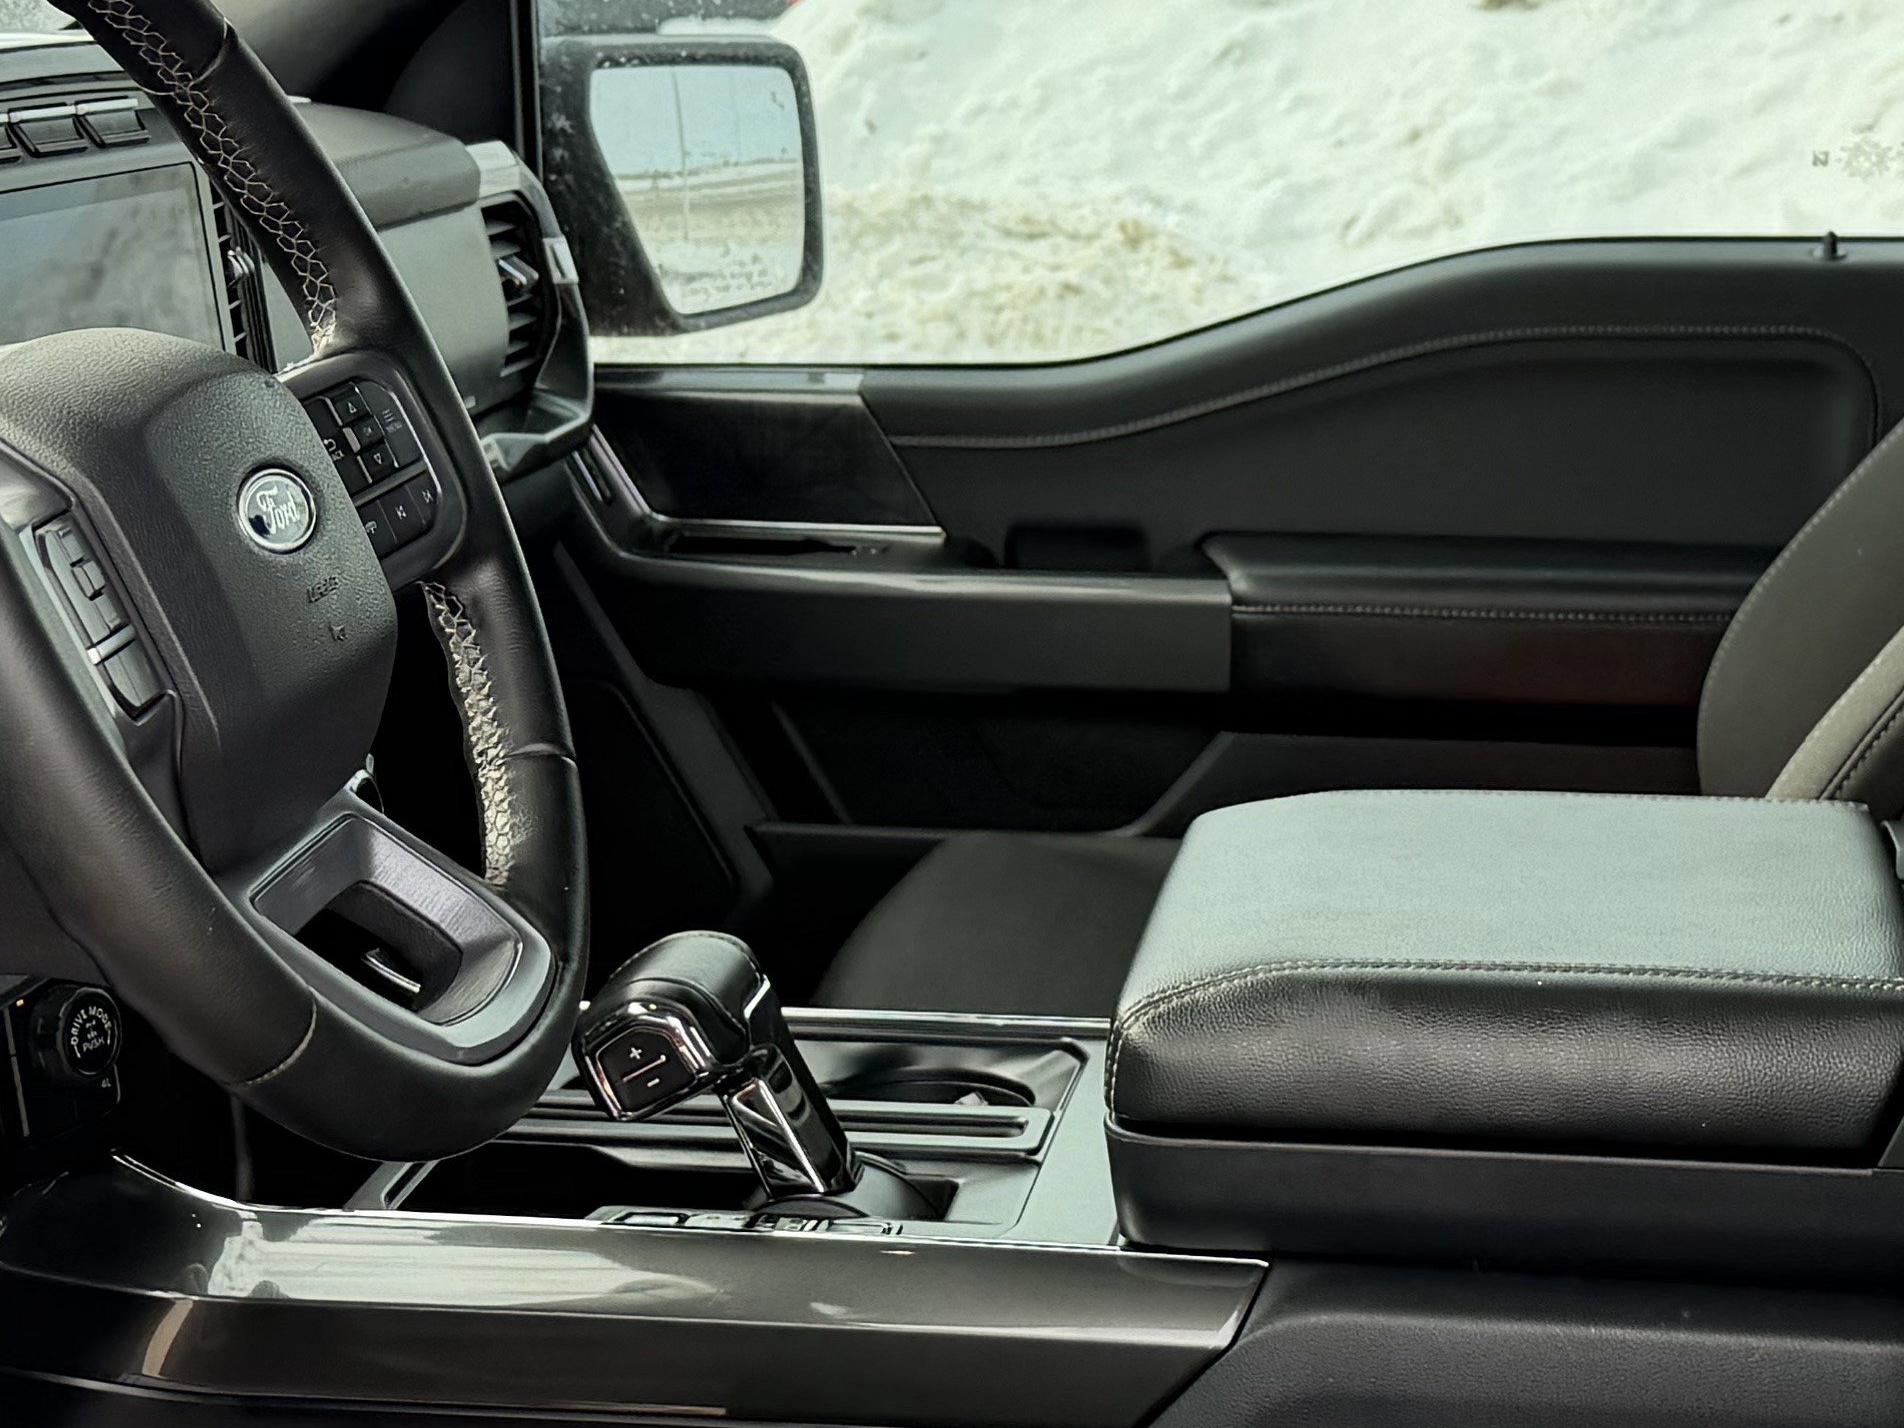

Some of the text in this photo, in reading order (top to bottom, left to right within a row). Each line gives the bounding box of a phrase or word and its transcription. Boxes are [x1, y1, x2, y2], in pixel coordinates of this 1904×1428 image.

[255, 485, 301, 536] Ford
[70, 1009, 88, 1046] DRIVE
[88, 1005, 113, 1032] MODE
